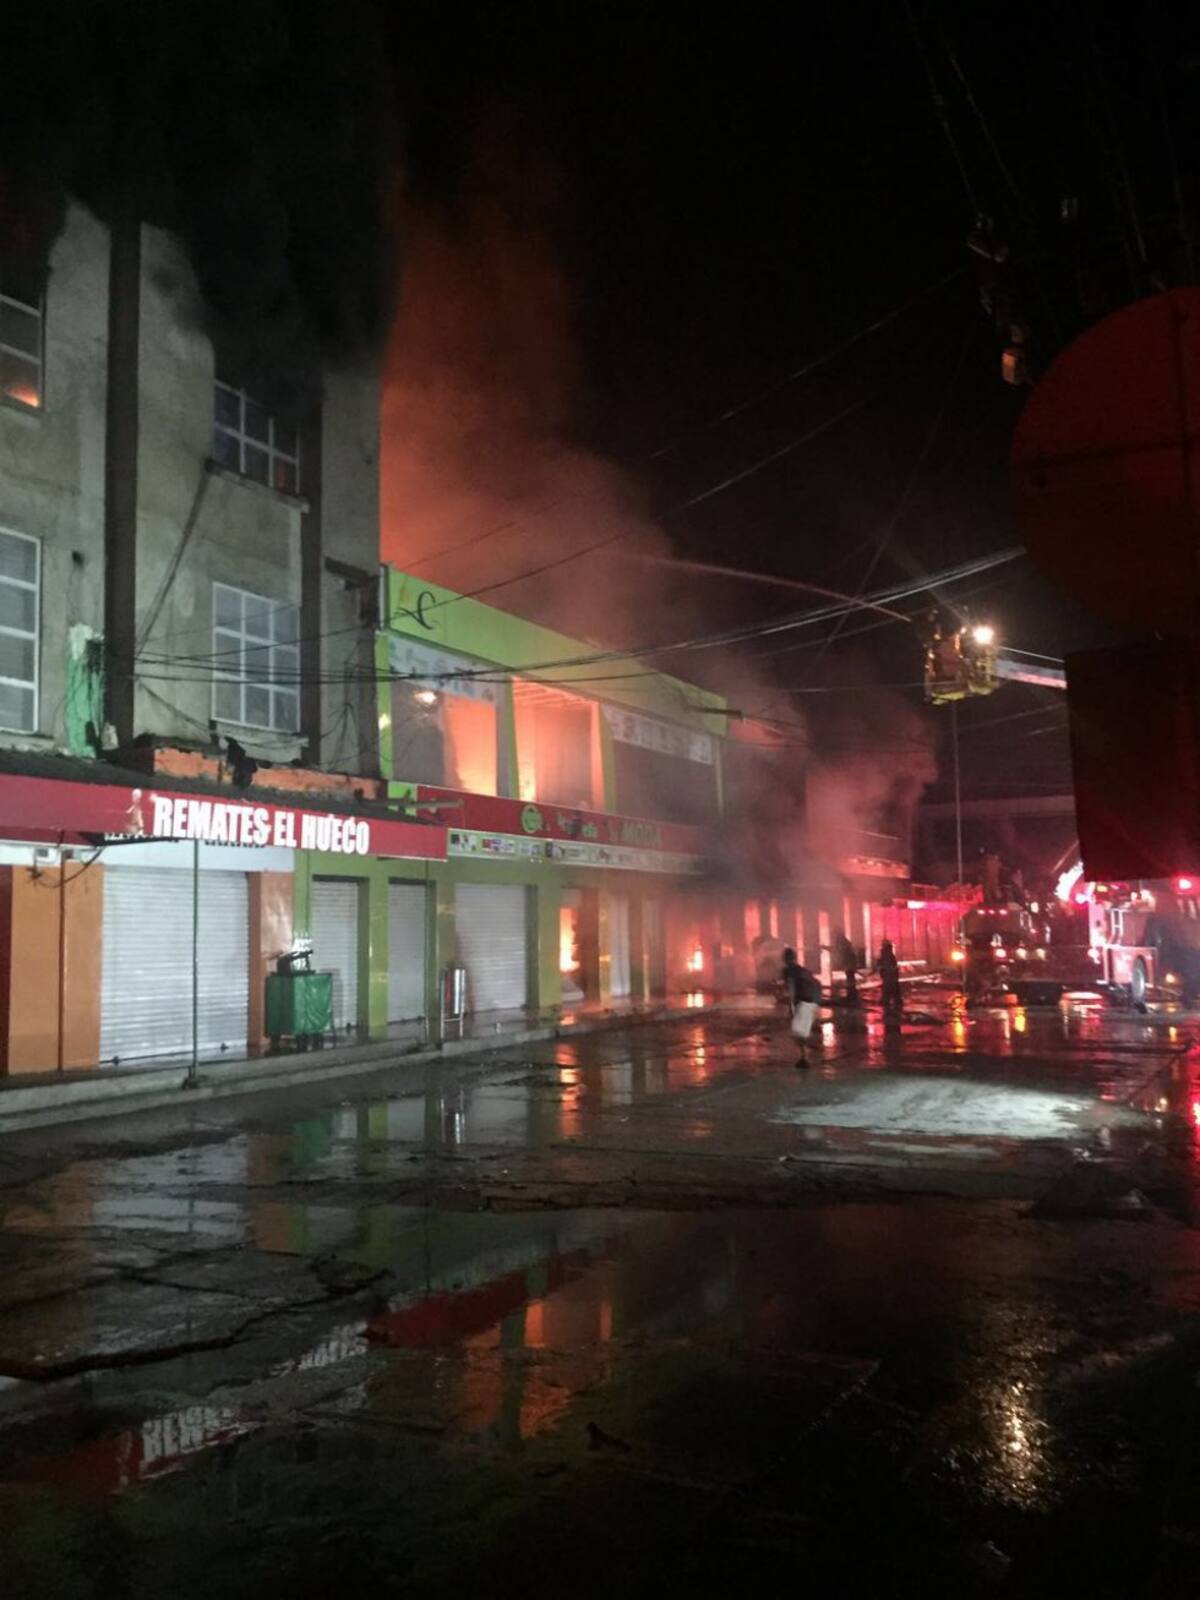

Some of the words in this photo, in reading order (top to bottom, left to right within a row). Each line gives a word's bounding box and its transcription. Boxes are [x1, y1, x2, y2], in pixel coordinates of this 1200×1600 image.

[152, 797, 270, 844] REMATES
[274, 810, 297, 847] EL
[302, 815, 370, 855] HUECO
